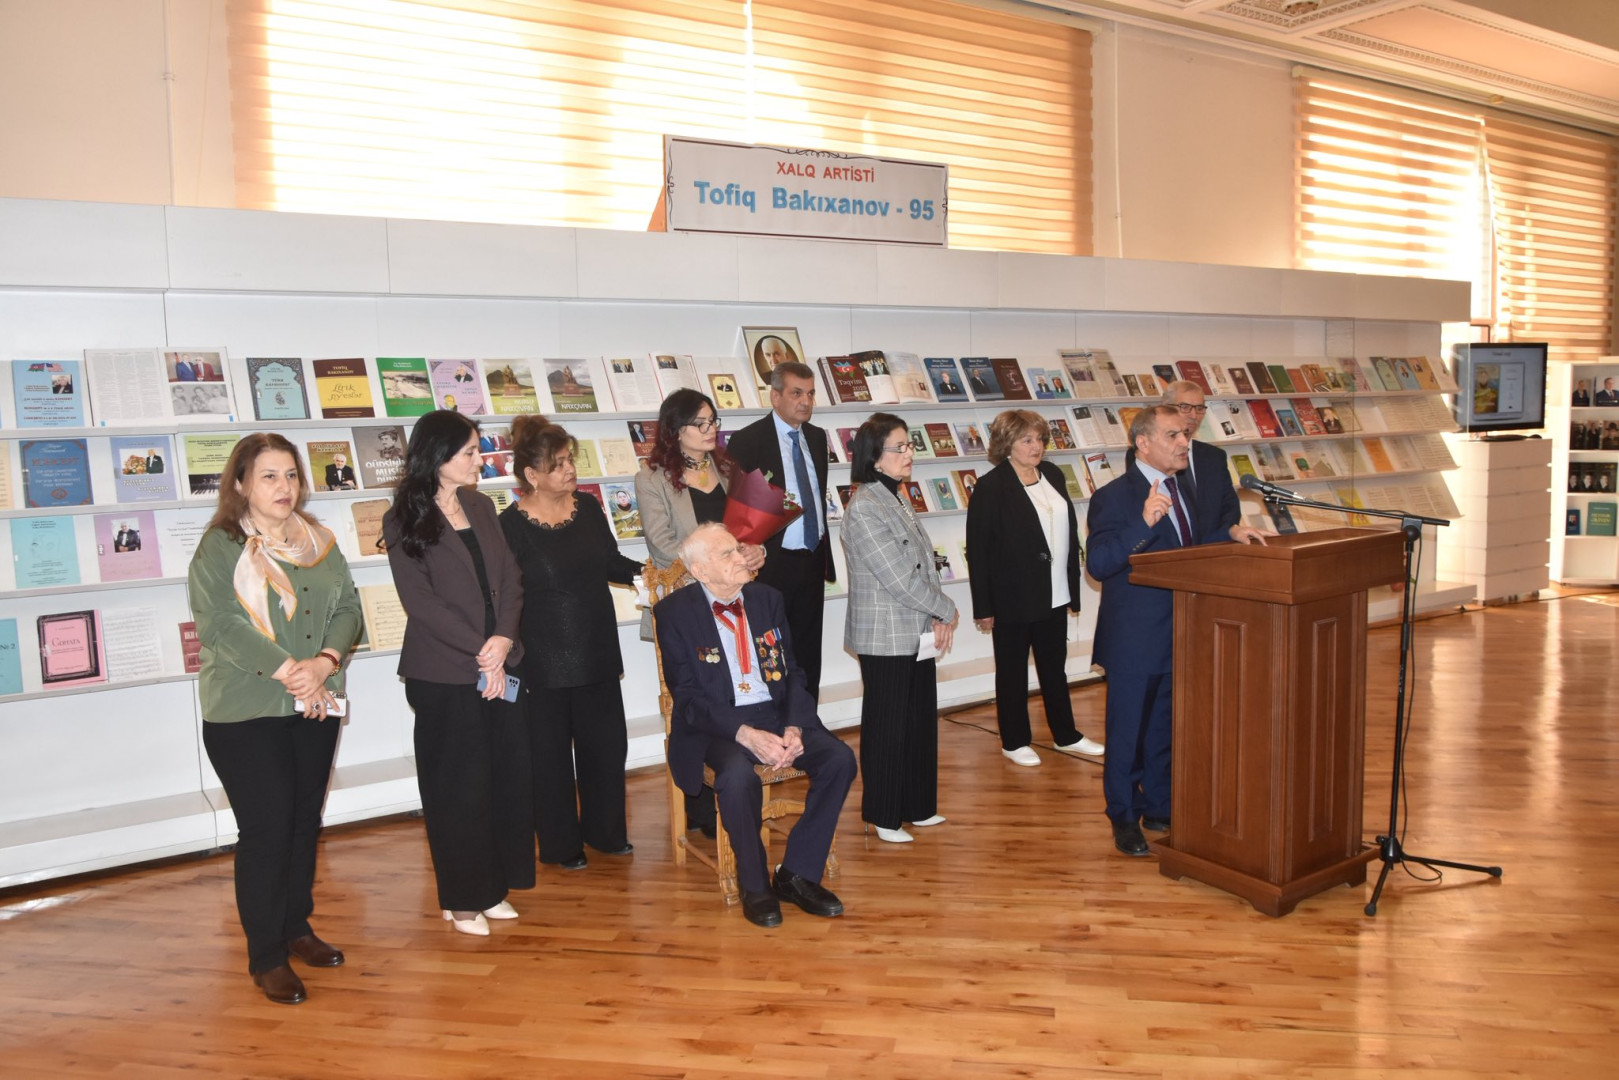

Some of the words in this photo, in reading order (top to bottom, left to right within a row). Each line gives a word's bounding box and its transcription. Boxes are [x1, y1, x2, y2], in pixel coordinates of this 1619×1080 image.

[776, 161, 816, 179] XALQ
[823, 165, 875, 183] ARTİSTİ
[693, 180, 757, 213] Tofiq
[772, 186, 890, 217] Bakıxanov
[909, 199, 934, 221] 95
